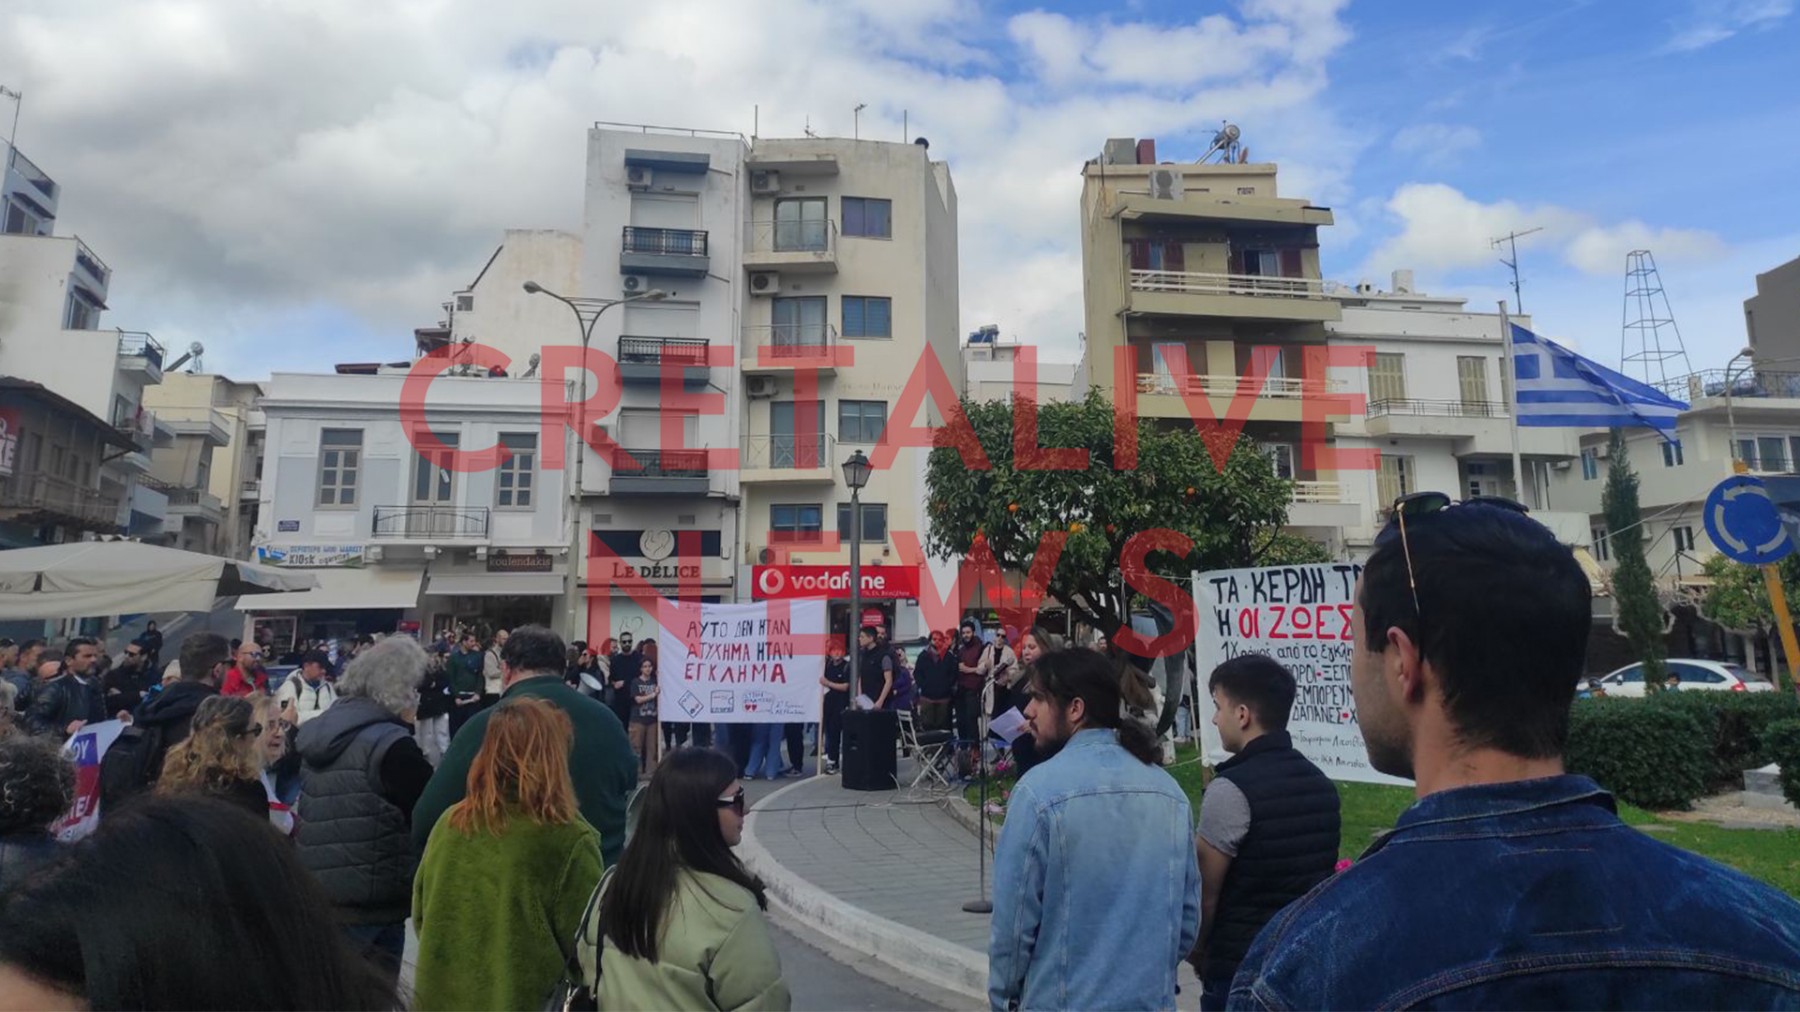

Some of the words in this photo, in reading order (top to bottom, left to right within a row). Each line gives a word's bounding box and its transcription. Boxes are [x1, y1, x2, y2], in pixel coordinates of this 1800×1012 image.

[641, 562, 700, 578] DÉLICE
[791, 571, 885, 589] vodafne
[1209, 575, 1240, 604] ΤΑ
[1251, 567, 1326, 604] ΚΕΡΔΗ
[686, 619, 728, 638] ΑΥΤΟ
[734, 619, 753, 638] ΔΕΝ
[758, 618, 791, 637] ΗΤΑΝ
[1238, 607, 1260, 639] ΟΙ
[1268, 604, 1354, 641] ΖΩΕΣ
[686, 642, 750, 661] ΑΤΥΧΗΜΑ
[756, 641, 793, 661] ΗΤΑΝ
[684, 663, 787, 684] ΕΓΚΛΗΜΑ
